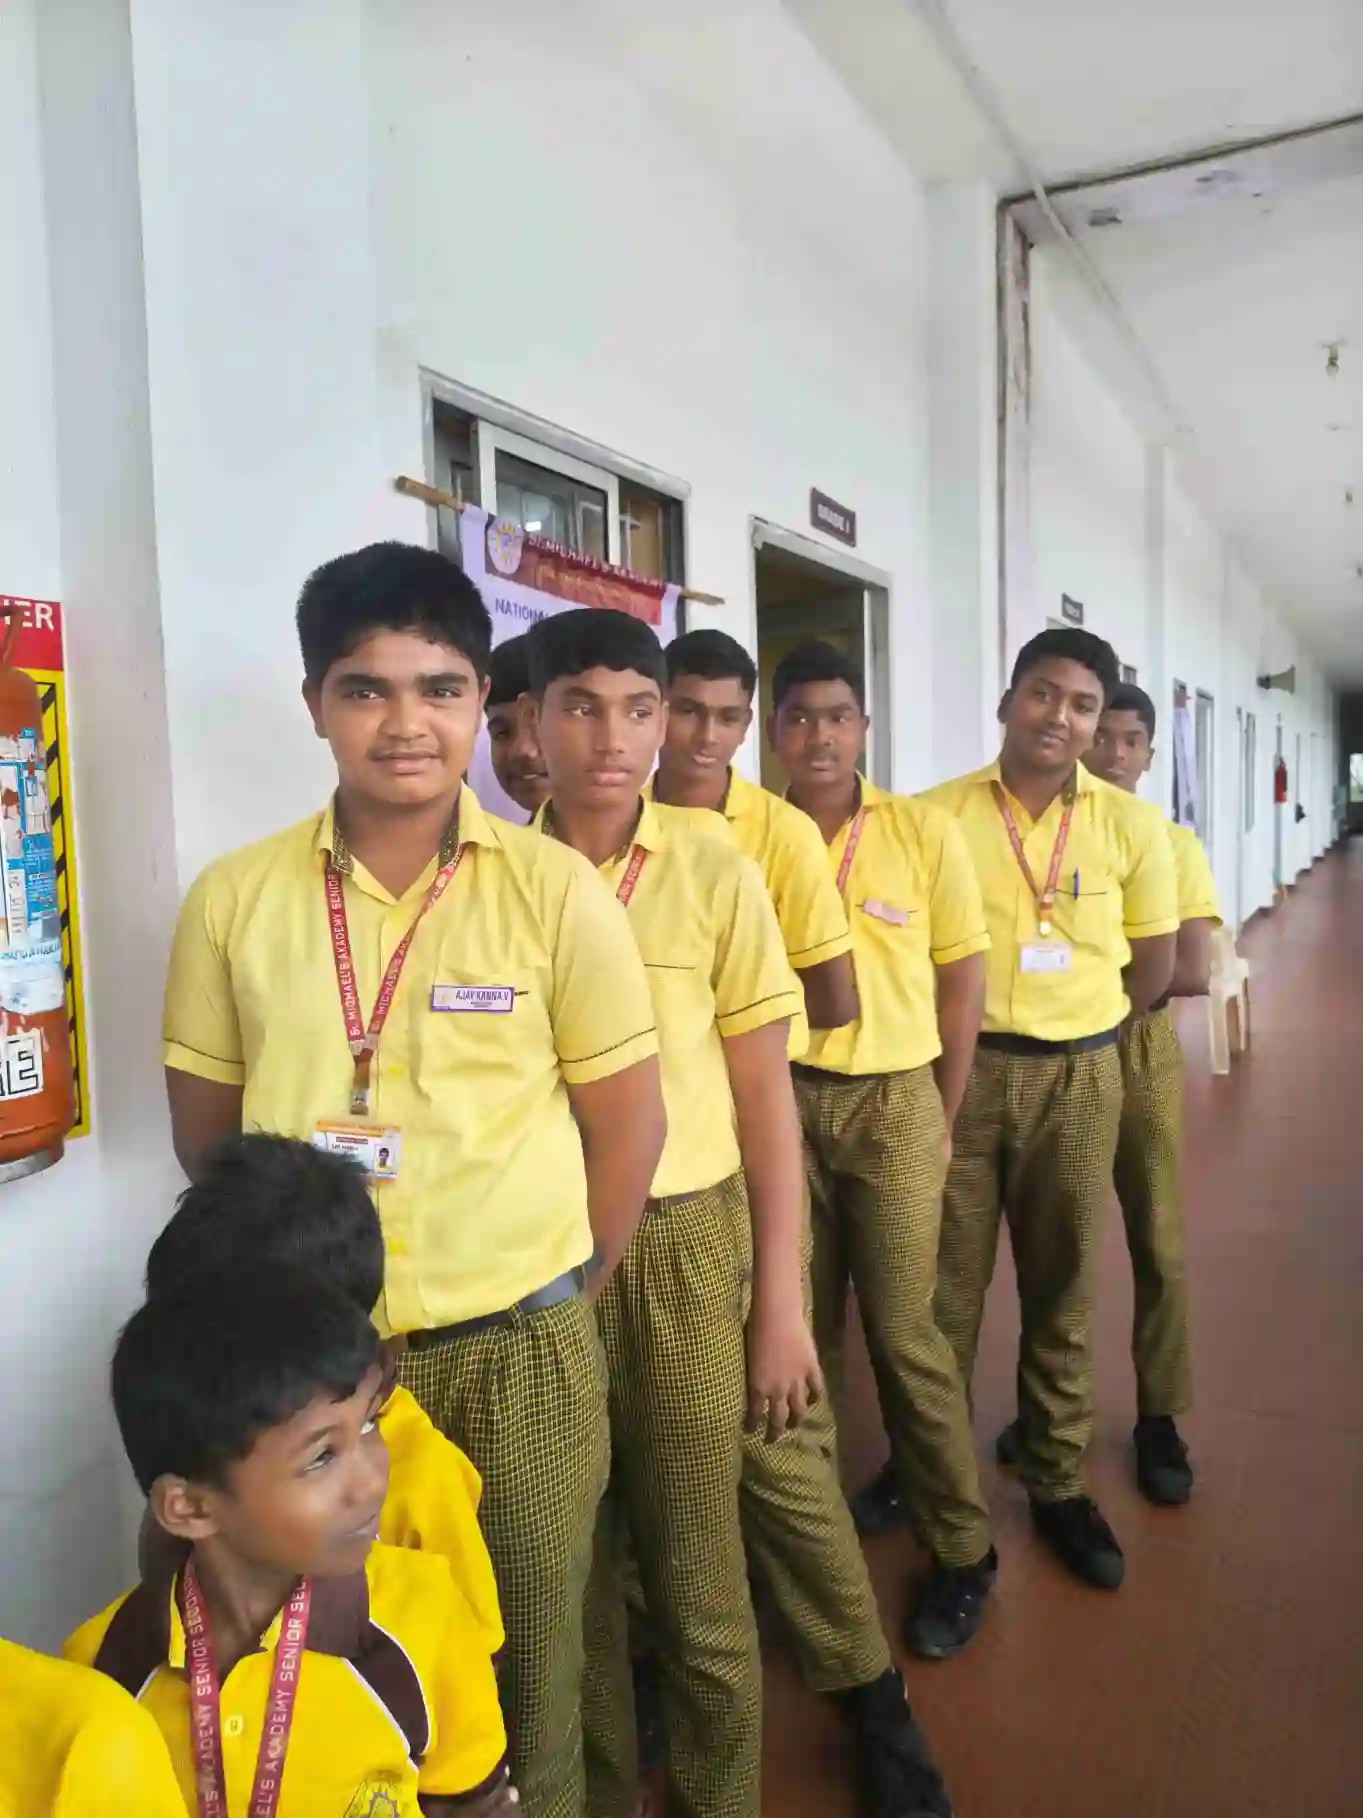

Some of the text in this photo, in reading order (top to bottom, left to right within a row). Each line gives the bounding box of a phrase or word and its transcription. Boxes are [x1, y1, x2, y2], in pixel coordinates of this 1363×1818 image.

[456, 989, 475, 1000] AJAY
[183, 1578, 204, 1635] SECOND
[192, 1637, 212, 1696] SENIOR
[280, 1617, 303, 1681] SENIOR
